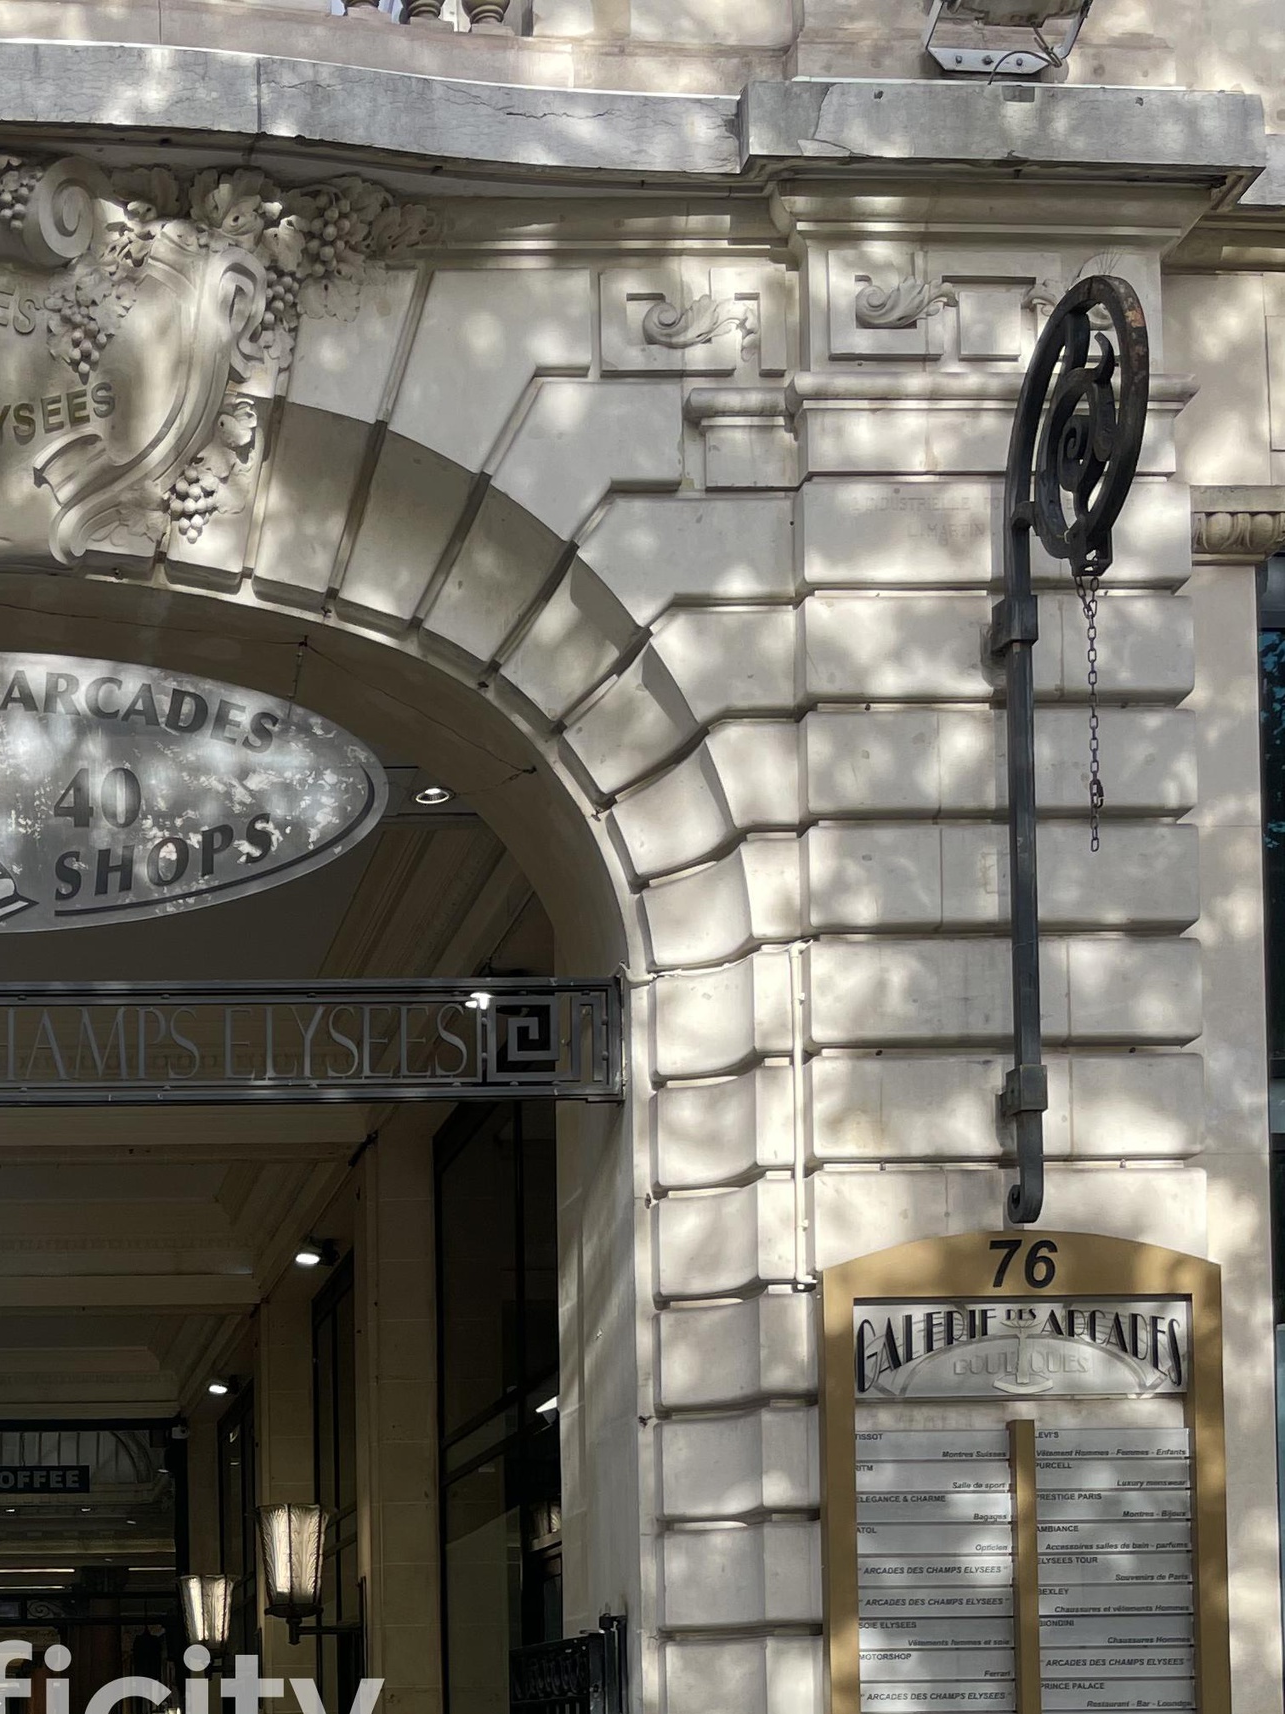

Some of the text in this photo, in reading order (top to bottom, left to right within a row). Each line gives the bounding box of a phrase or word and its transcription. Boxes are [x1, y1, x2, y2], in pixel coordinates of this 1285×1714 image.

[53, 767, 143, 830] 40
[54, 812, 273, 902] SHOPS
[223, 1003, 469, 1080] ELYSEES
[989, 1239, 1058, 1289] 76
[1006, 1308, 1037, 1321] DES
[953, 1351, 1089, 1375] BOUTQUES
[1077, 1493, 1102, 1501] PARIS
[1075, 1556, 1098, 1564] TOUR
[863, 1565, 1002, 1575] ARCADES DES CHAMPS ELYSEES
[1046, 1658, 1185, 1667] ARCADES DES CHAMPS ELYSEES
[1071, 1682, 1105, 1690] PALACE
[867, 1691, 1006, 1701] ARCADES DES CHAMPS ELYSEES
